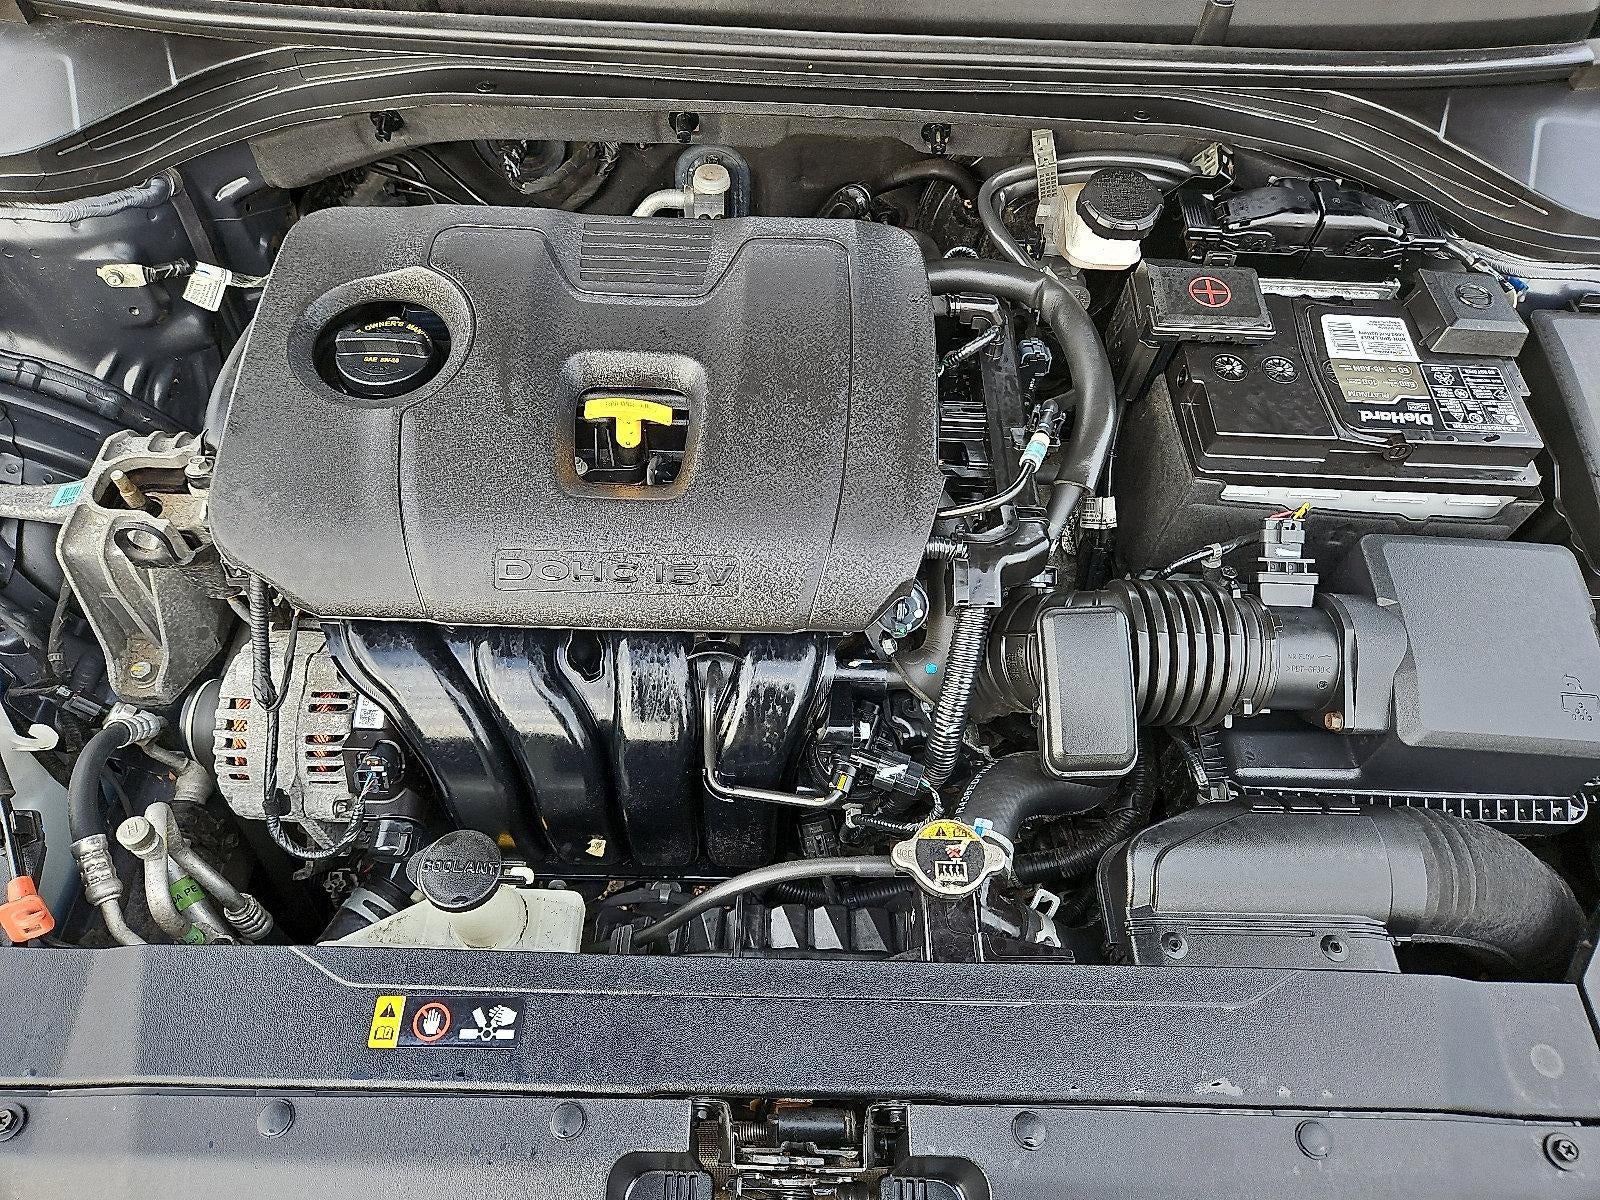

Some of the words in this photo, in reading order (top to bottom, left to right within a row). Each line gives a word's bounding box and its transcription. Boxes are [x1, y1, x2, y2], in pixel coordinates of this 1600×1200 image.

[365, 320, 404, 331] OWNER'S
[1359, 410, 1434, 426] DieHard
[499, 558, 639, 583] DOHC
[653, 563, 736, 587] 16V
[421, 860, 500, 876] COOLANT
